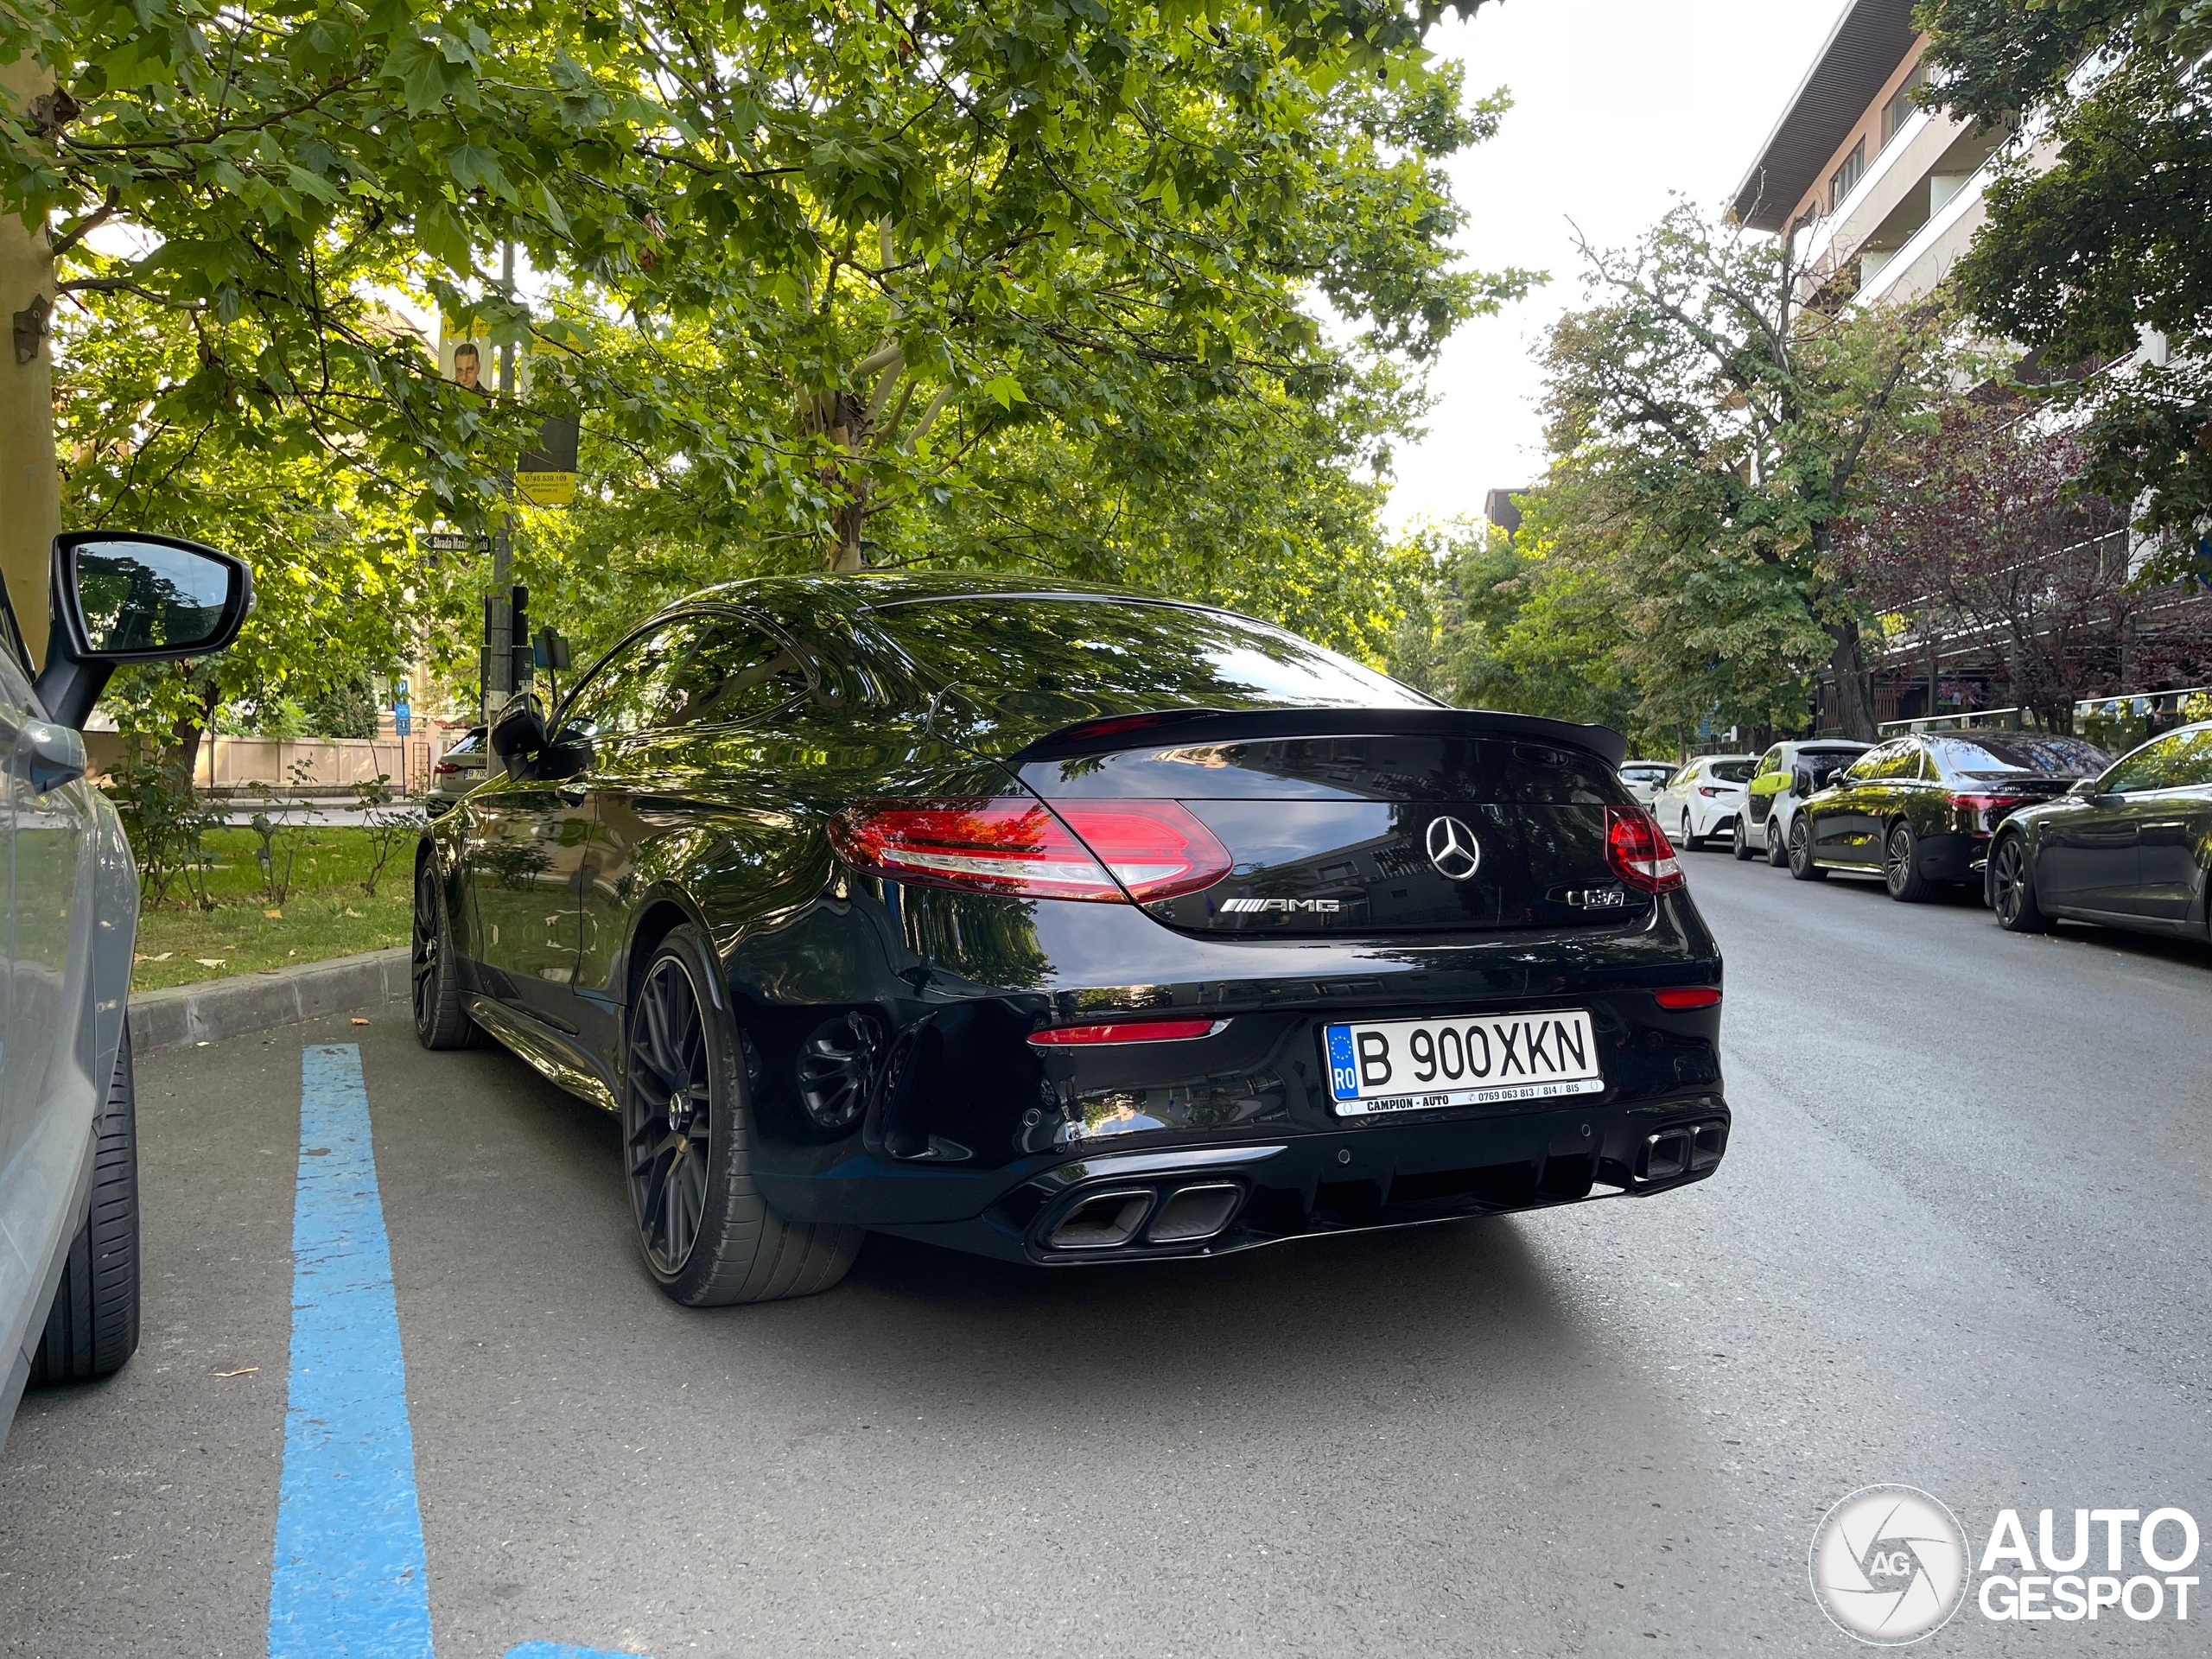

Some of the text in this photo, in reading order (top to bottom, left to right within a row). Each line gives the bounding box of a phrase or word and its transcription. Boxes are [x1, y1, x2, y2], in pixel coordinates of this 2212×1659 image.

[433, 537, 452, 549] Strada
[1260, 899, 1339, 912] AMG
[1357, 1020, 1586, 1087] B 900XKN
[1334, 1067, 1355, 1090] RO
[1478, 1091, 1500, 1102] 0769
[1502, 1090, 1518, 1100] 063
[1520, 1088, 1535, 1097] 813
[1543, 1085, 1557, 1095] 814
[1566, 1084, 1580, 1093] 815
[1367, 1098, 1414, 1111] CAMPION
[1422, 1095, 1449, 1107] AUTO
